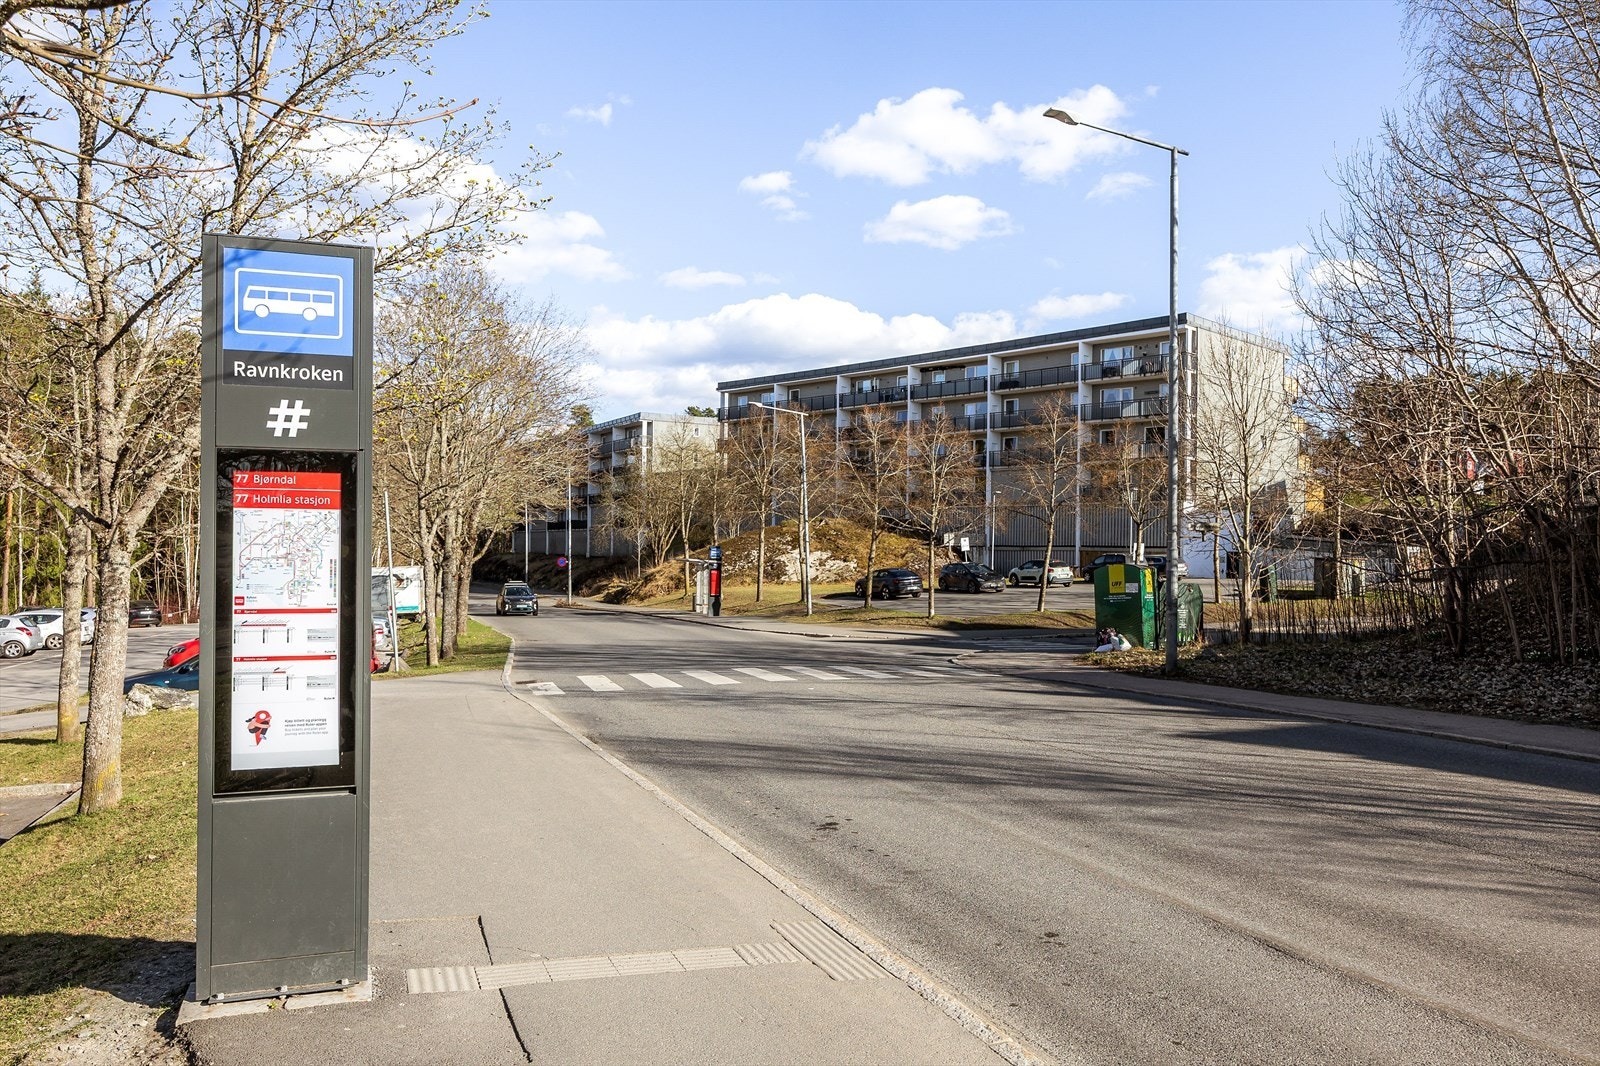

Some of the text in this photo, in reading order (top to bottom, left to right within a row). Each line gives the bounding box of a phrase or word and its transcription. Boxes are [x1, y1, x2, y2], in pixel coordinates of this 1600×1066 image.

[234, 361, 344, 382] Ravnkroken
[235, 474, 296, 485] 77 Bjørndal
[235, 494, 331, 506] 77 Holmlia stasjon
